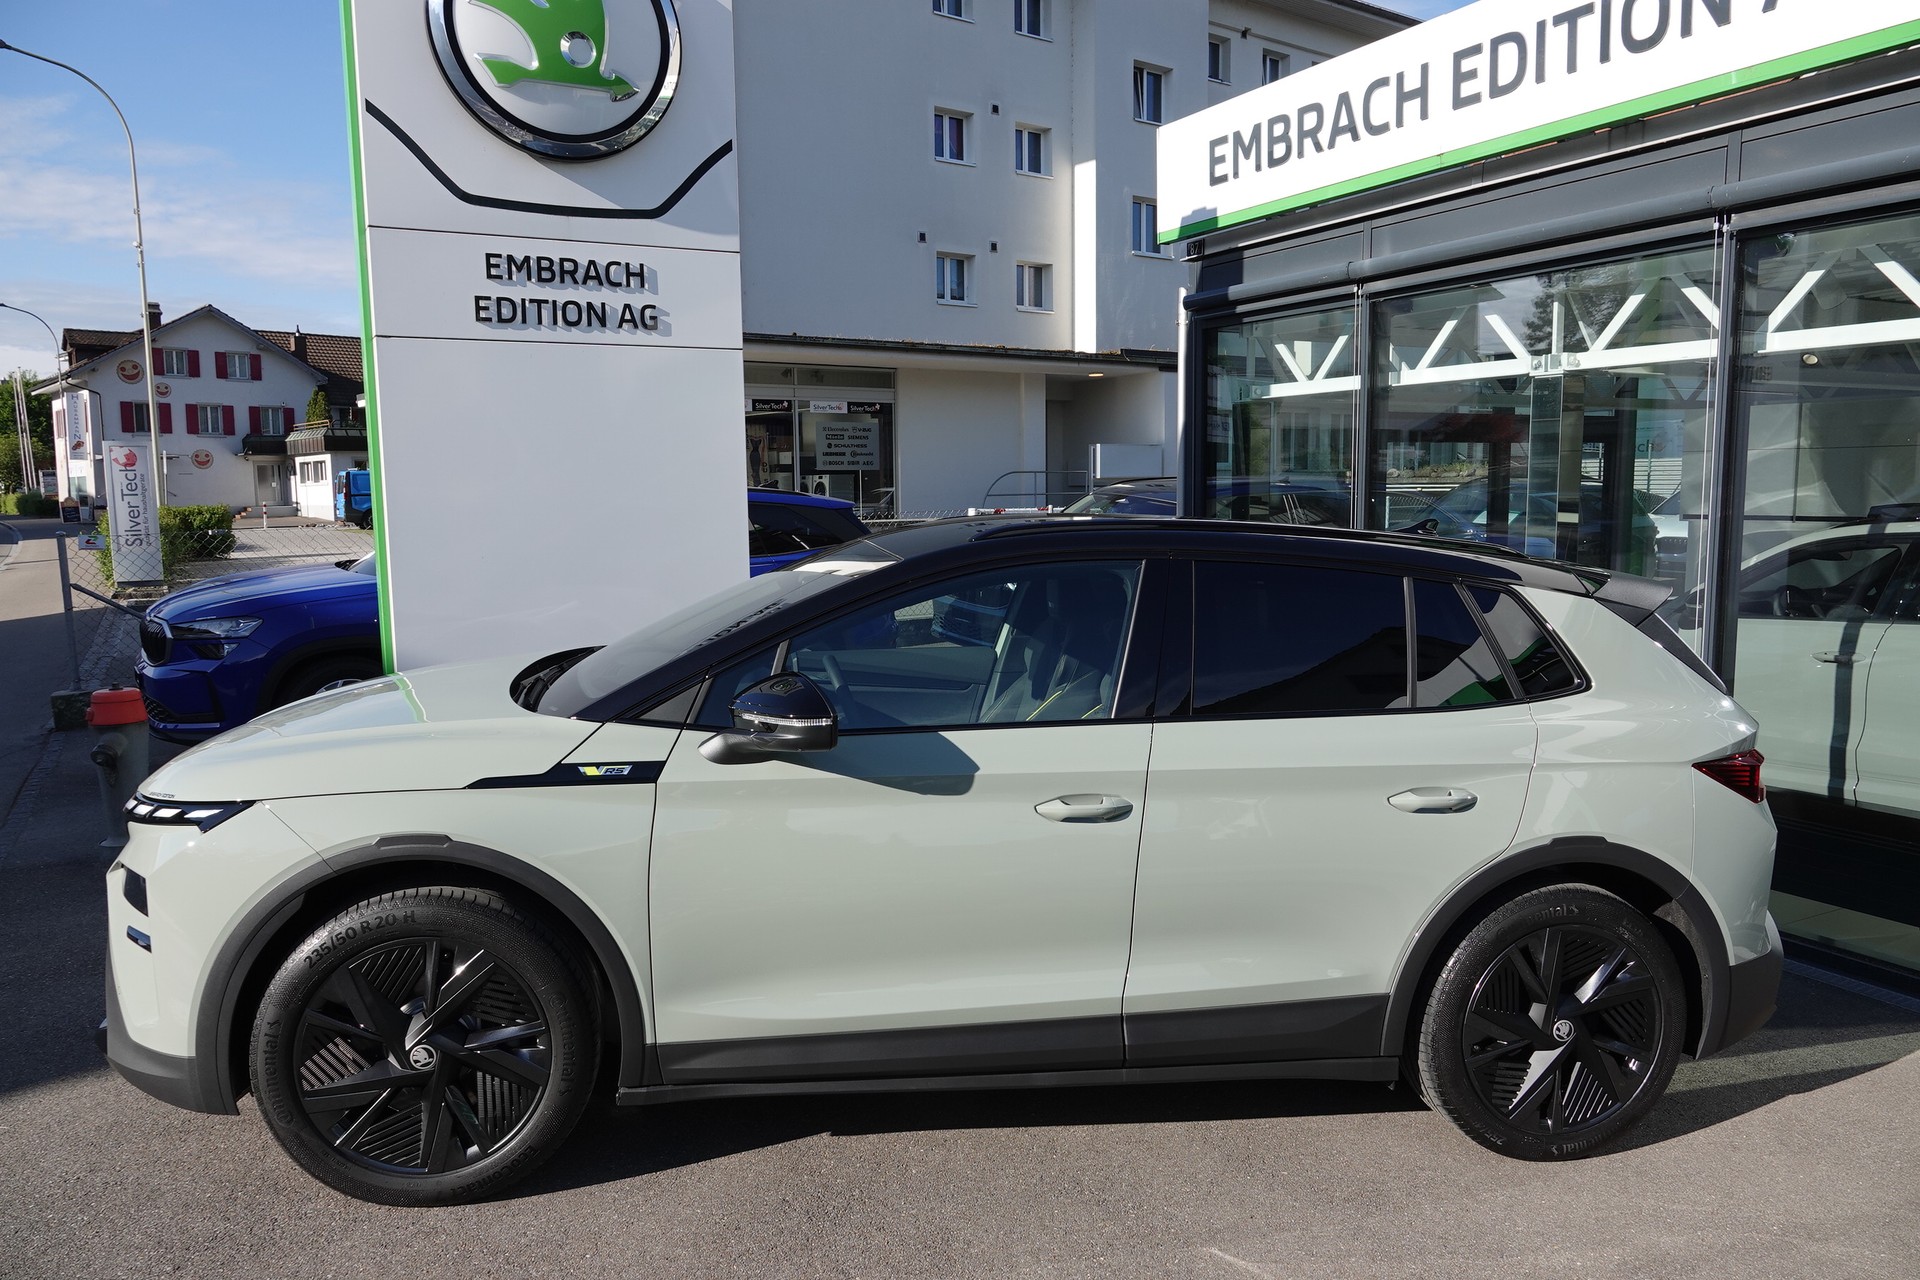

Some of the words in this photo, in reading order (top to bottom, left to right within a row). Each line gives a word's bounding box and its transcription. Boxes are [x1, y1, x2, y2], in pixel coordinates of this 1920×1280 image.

[1209, 62, 1429, 187] EMBRACH
[485, 252, 646, 289] EMBRACH
[474, 295, 607, 328] EDITION
[617, 303, 659, 331] AG
[303, 926, 358, 969] 235/50
[361, 920, 373, 934] R
[374, 913, 397, 929] 20
